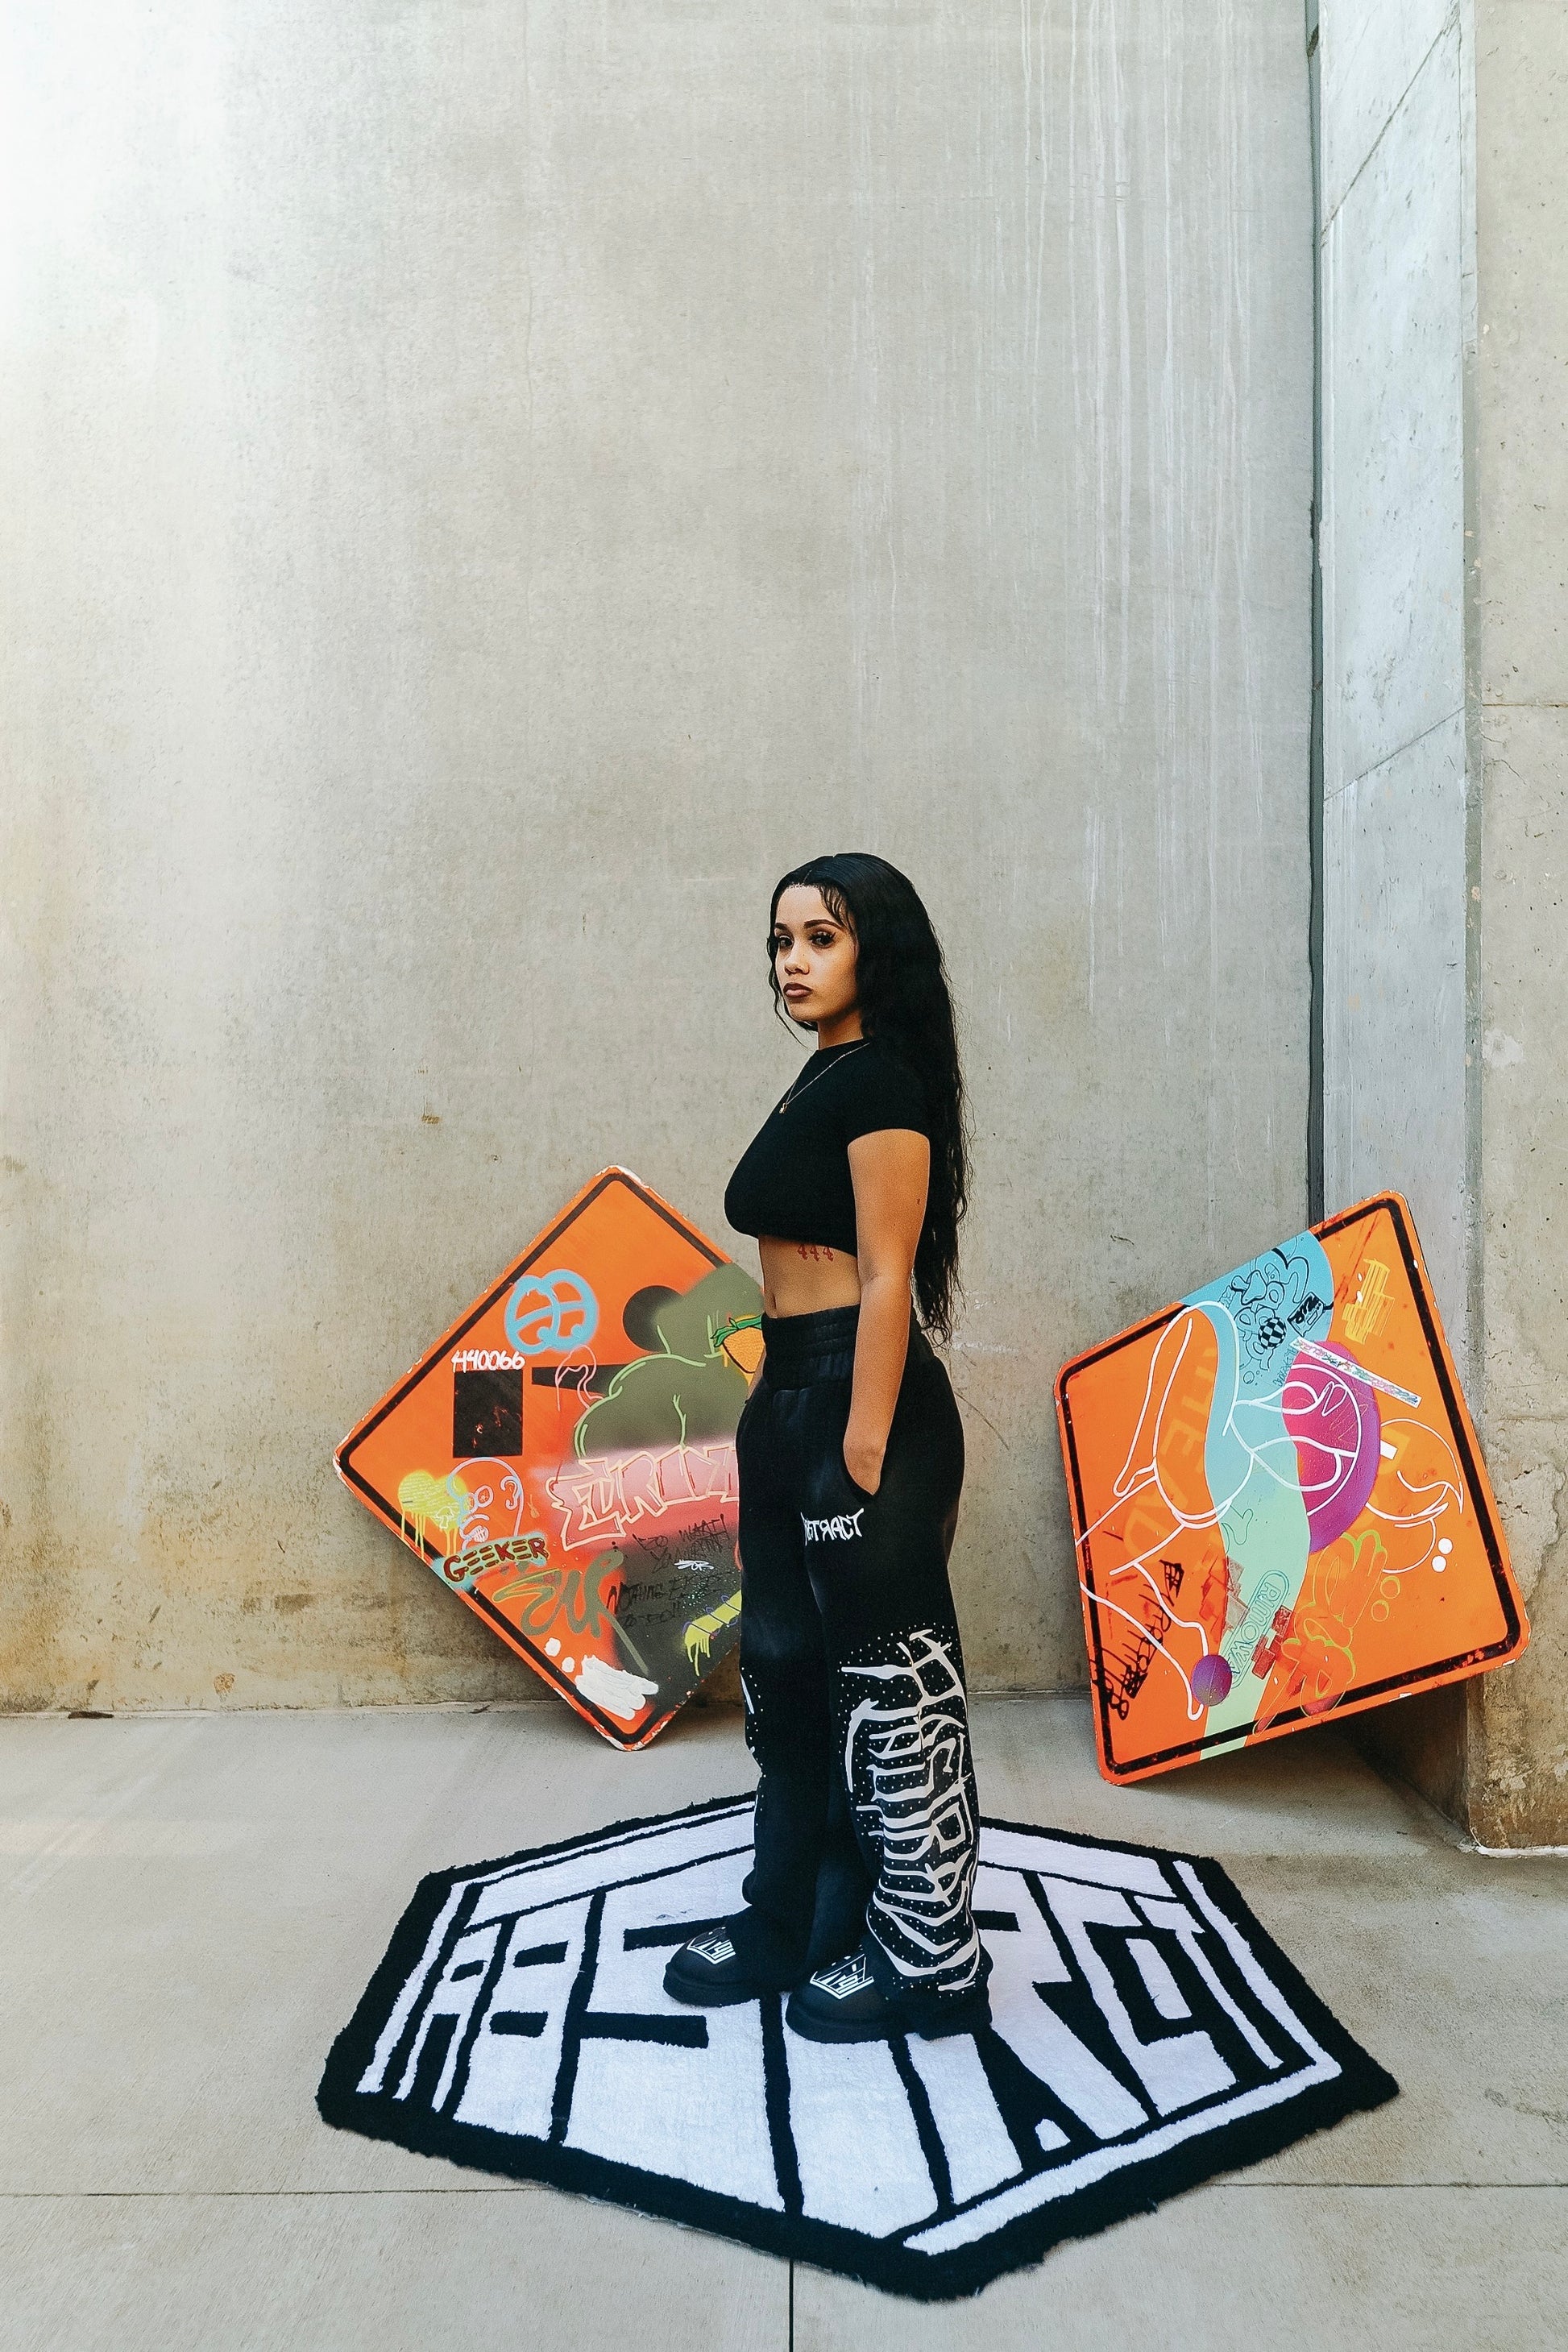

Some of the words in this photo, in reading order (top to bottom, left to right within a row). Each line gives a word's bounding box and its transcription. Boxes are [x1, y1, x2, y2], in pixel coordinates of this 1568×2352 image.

[796, 1243, 834, 1262] 444
[451, 1349, 526, 1373] 440066
[443, 1537, 550, 1582] GEEKER
[1229, 1580, 1283, 1675] RIMOWA
